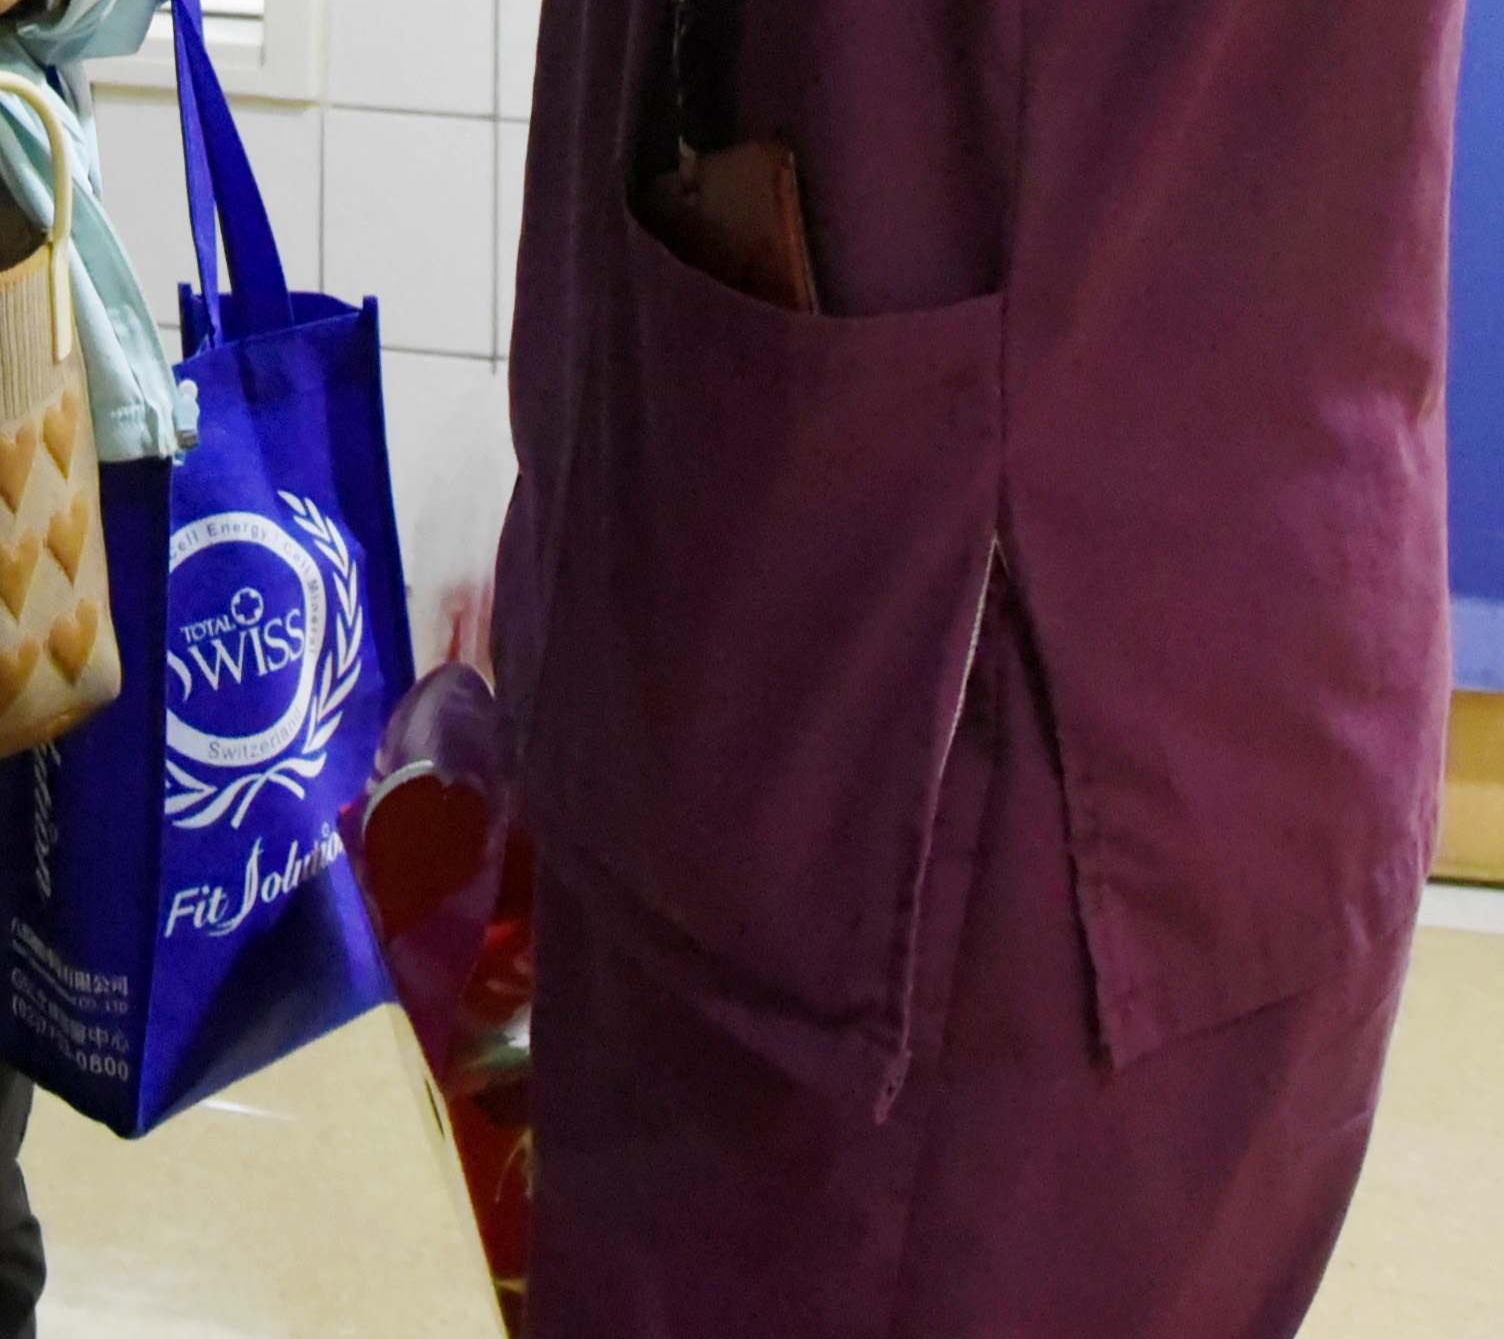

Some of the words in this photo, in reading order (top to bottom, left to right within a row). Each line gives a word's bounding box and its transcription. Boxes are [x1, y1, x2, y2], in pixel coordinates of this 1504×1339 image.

[206, 522, 267, 542] Energy
[180, 614, 237, 644] TOTAL
[208, 705, 303, 761] Switzerland
[164, 883, 226, 939] Fit
